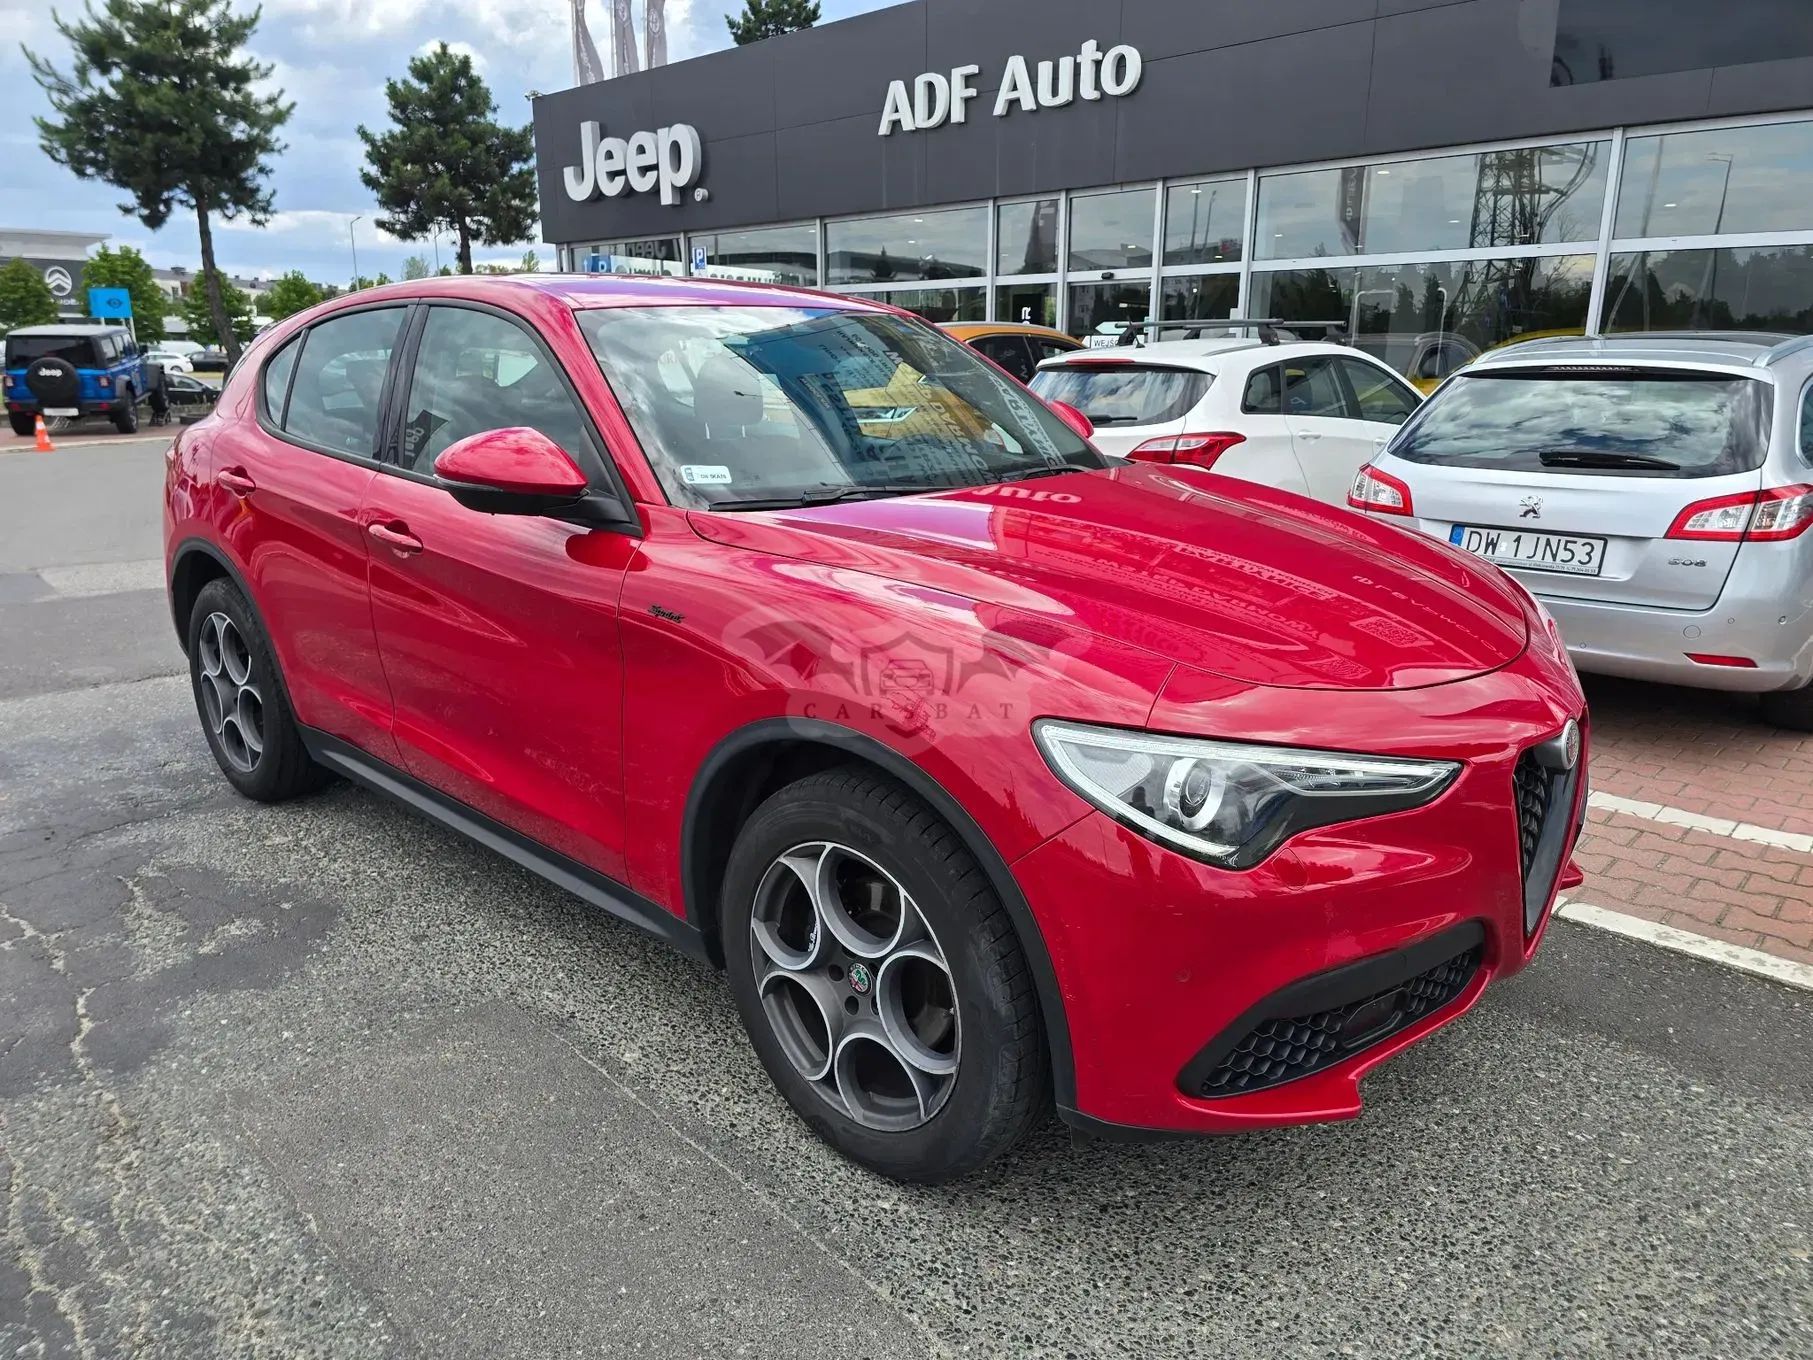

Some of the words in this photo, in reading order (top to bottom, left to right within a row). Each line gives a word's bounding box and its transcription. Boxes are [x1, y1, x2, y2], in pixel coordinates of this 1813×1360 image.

[878, 64, 979, 136] ADF
[993, 39, 1142, 116] Auto
[563, 120, 702, 206] Jeep
[38, 367, 63, 377] Jeep
[1466, 530, 1501, 555] DW
[1512, 534, 1596, 566] 1JN53
